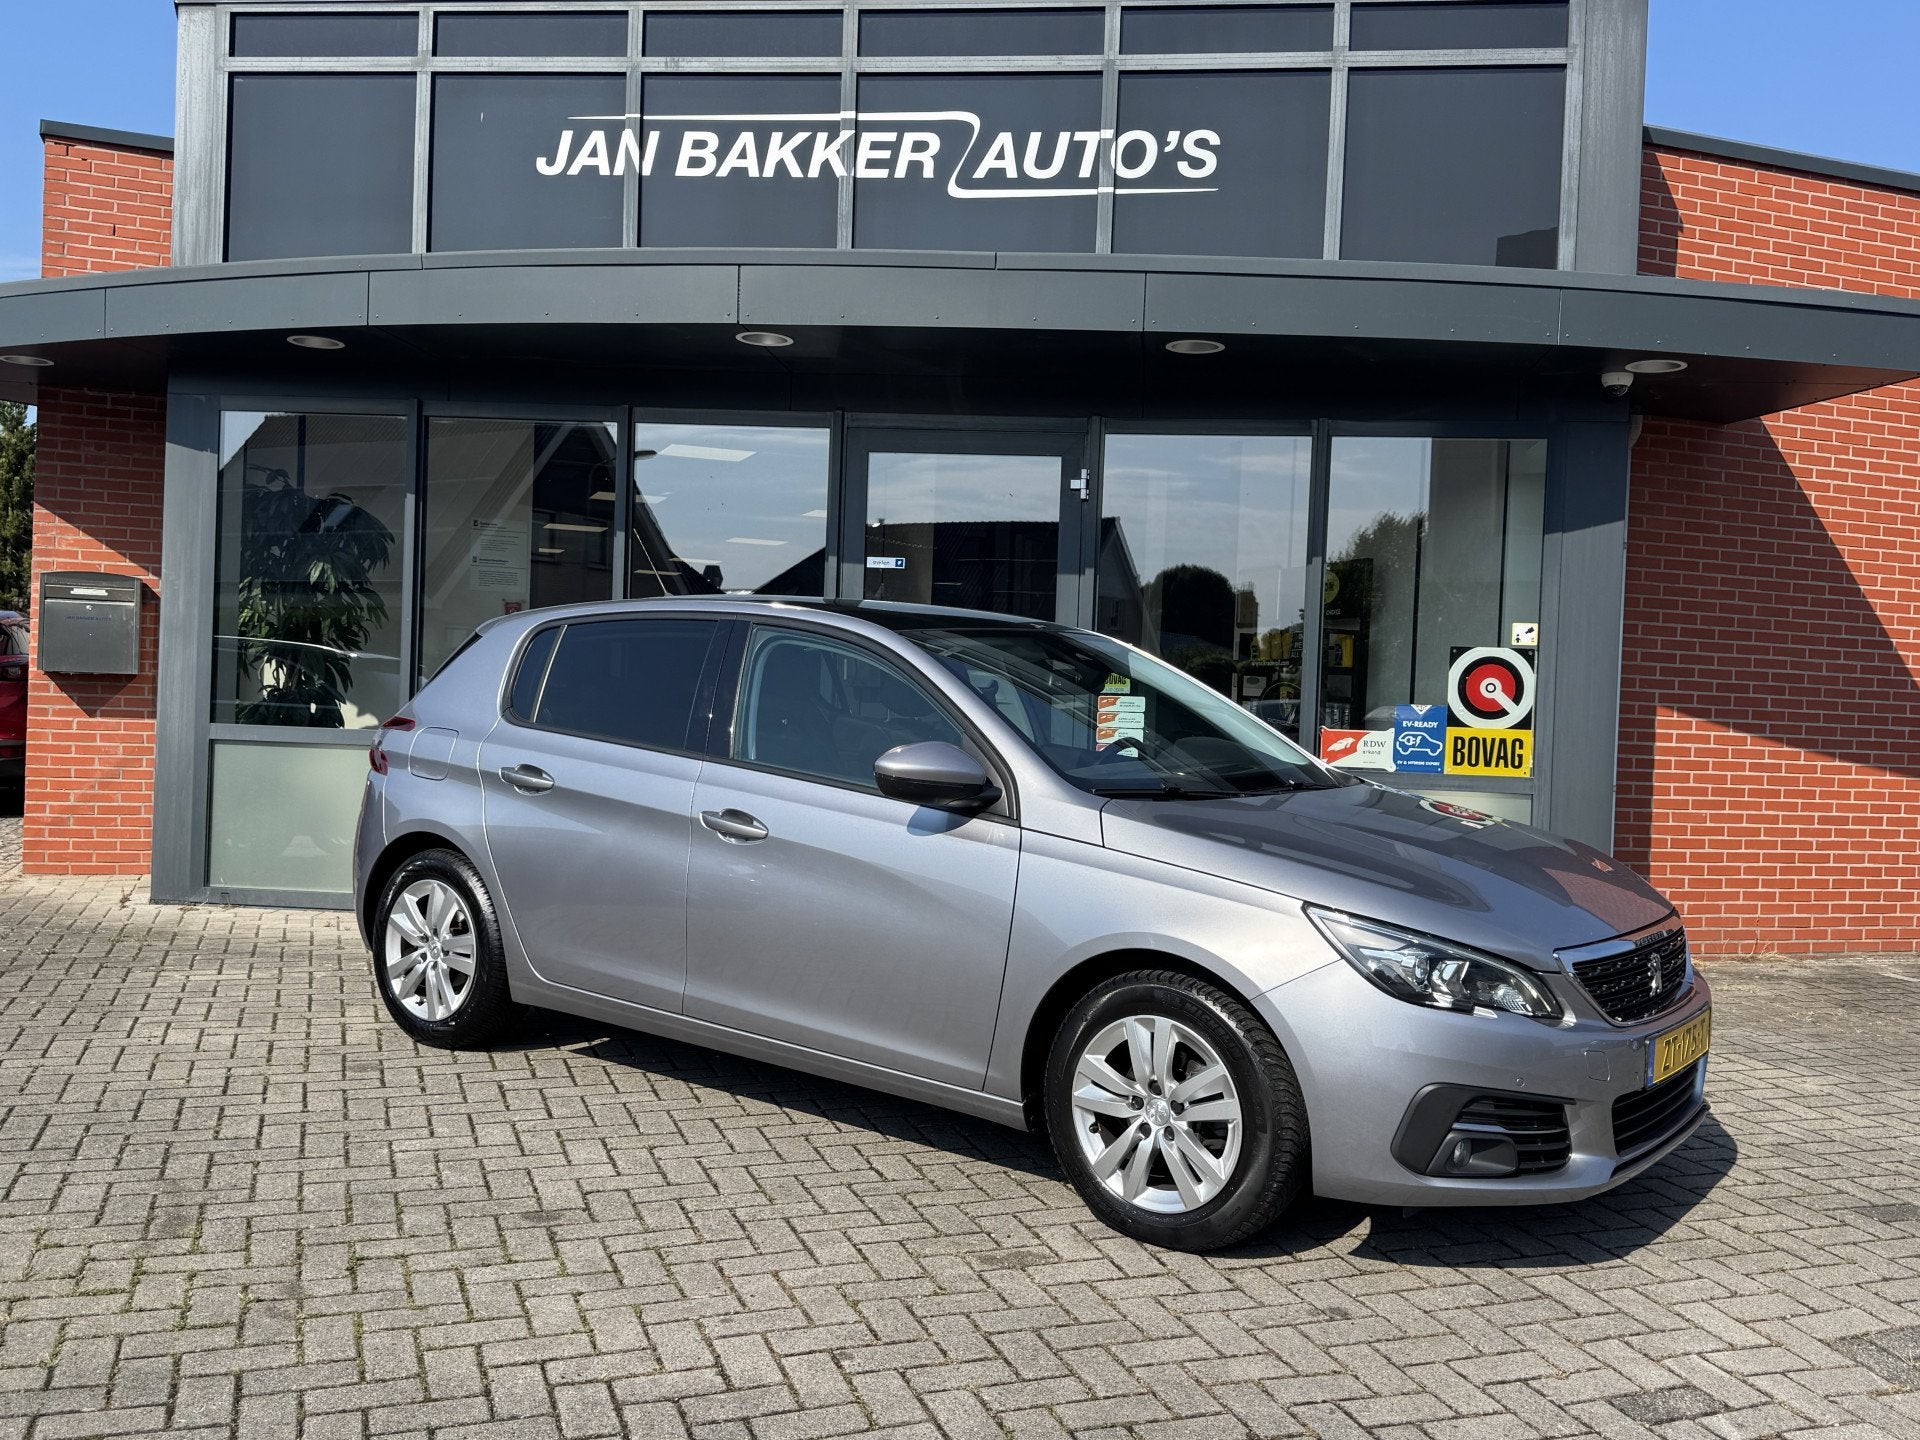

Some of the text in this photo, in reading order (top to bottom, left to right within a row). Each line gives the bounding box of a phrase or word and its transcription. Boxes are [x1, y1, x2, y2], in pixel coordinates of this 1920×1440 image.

[536, 128, 1221, 179] JAN BAKKER AUTO'S
[1402, 720, 1439, 729] EV-READY
[1363, 740, 1387, 748] RDW
[1452, 736, 1524, 770] BOVAG
